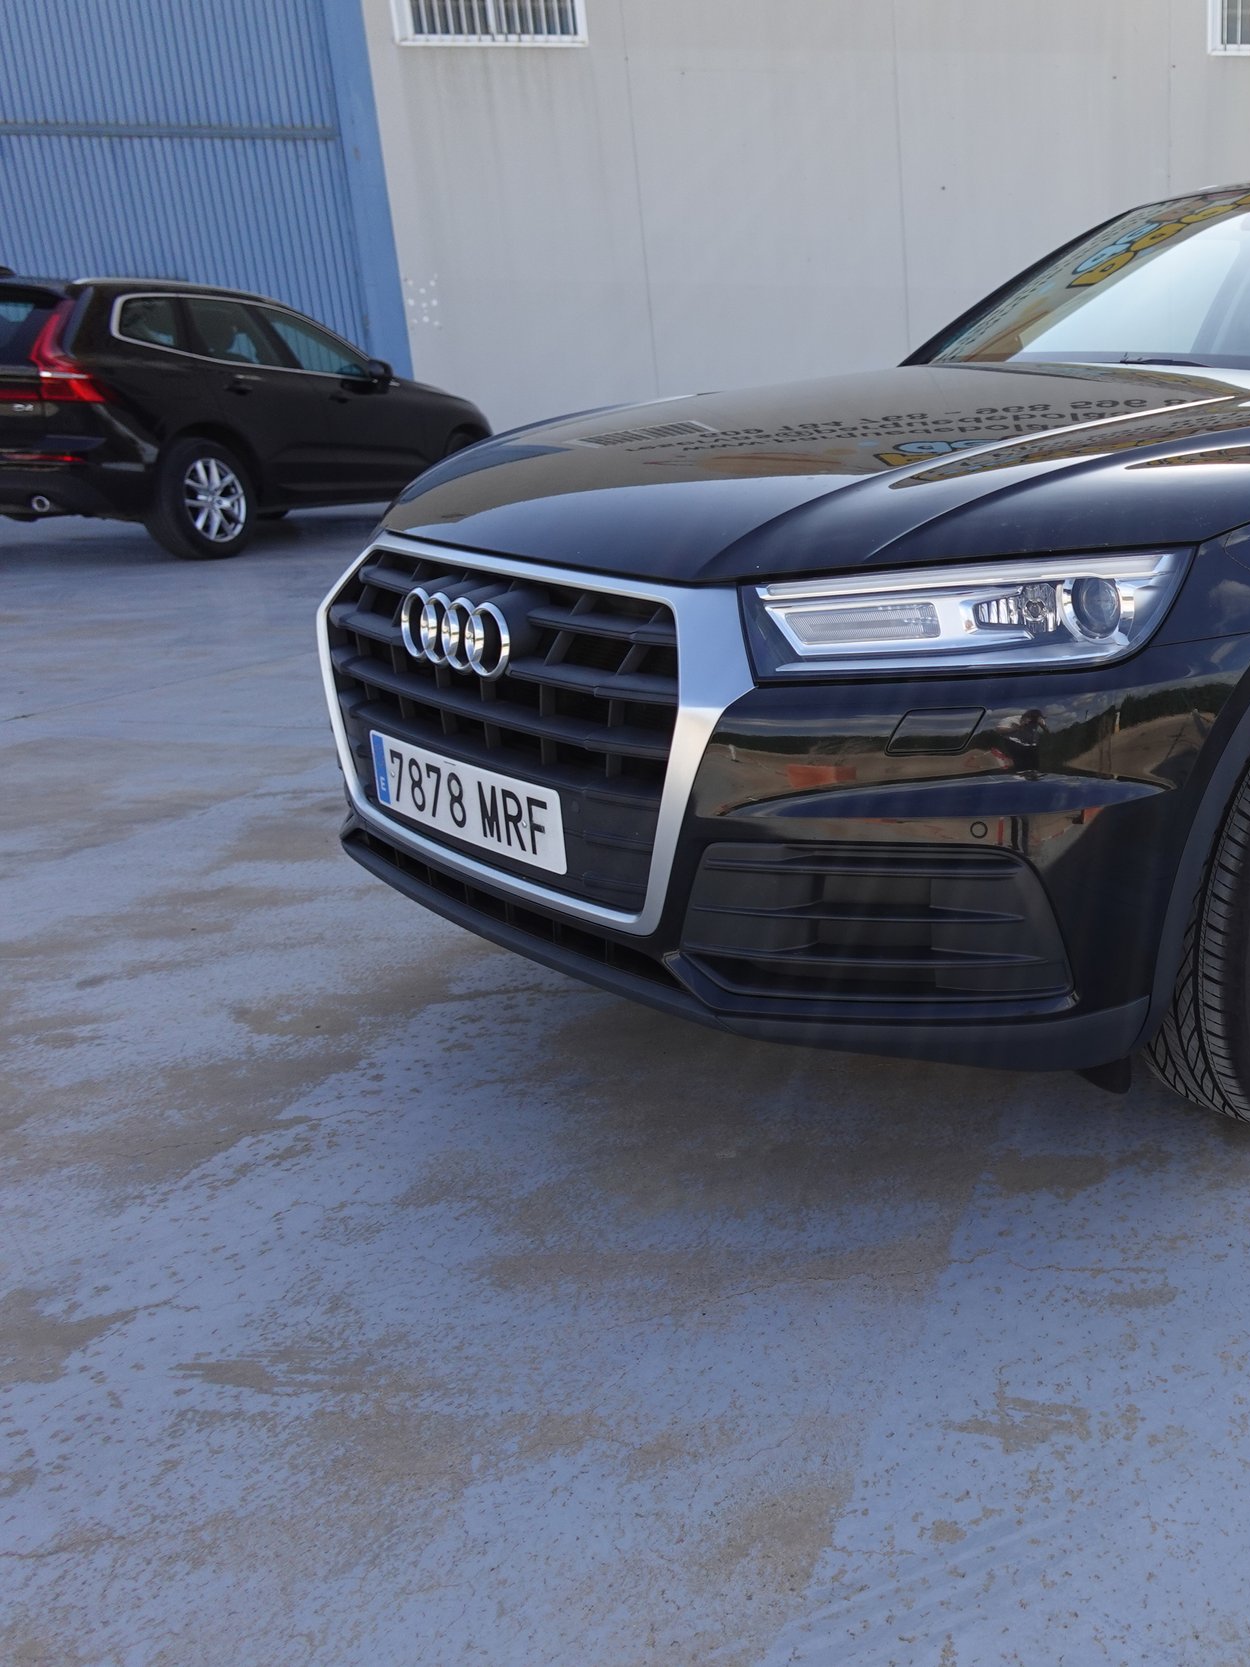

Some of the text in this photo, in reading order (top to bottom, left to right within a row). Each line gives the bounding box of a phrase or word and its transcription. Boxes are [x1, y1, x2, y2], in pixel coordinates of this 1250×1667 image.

[379, 777, 386, 792] E
[389, 748, 548, 855] 7878 MRF
